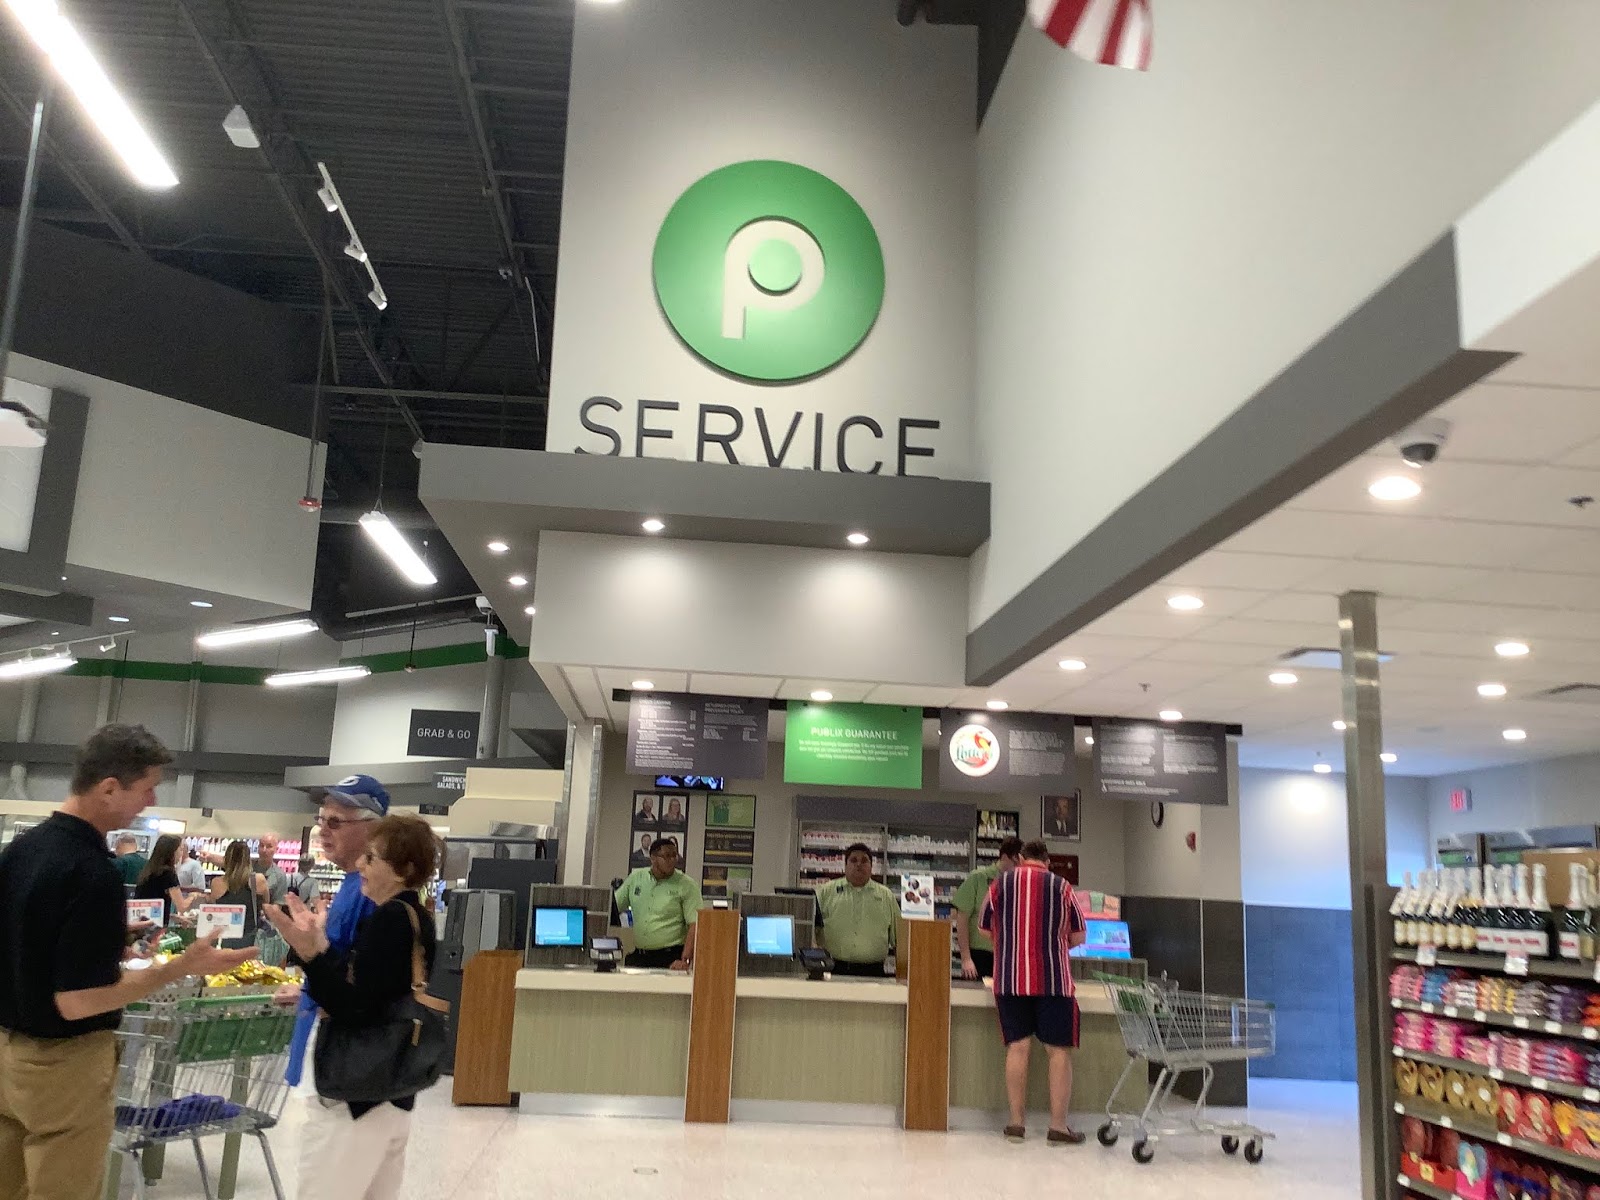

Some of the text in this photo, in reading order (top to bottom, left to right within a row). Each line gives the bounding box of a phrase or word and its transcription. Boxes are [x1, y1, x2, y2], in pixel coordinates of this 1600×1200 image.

[574, 396, 940, 478] SERVICE
[417, 728, 471, 739] GRAB & GO
[810, 727, 898, 740] PUBLIX GUARANTEE
